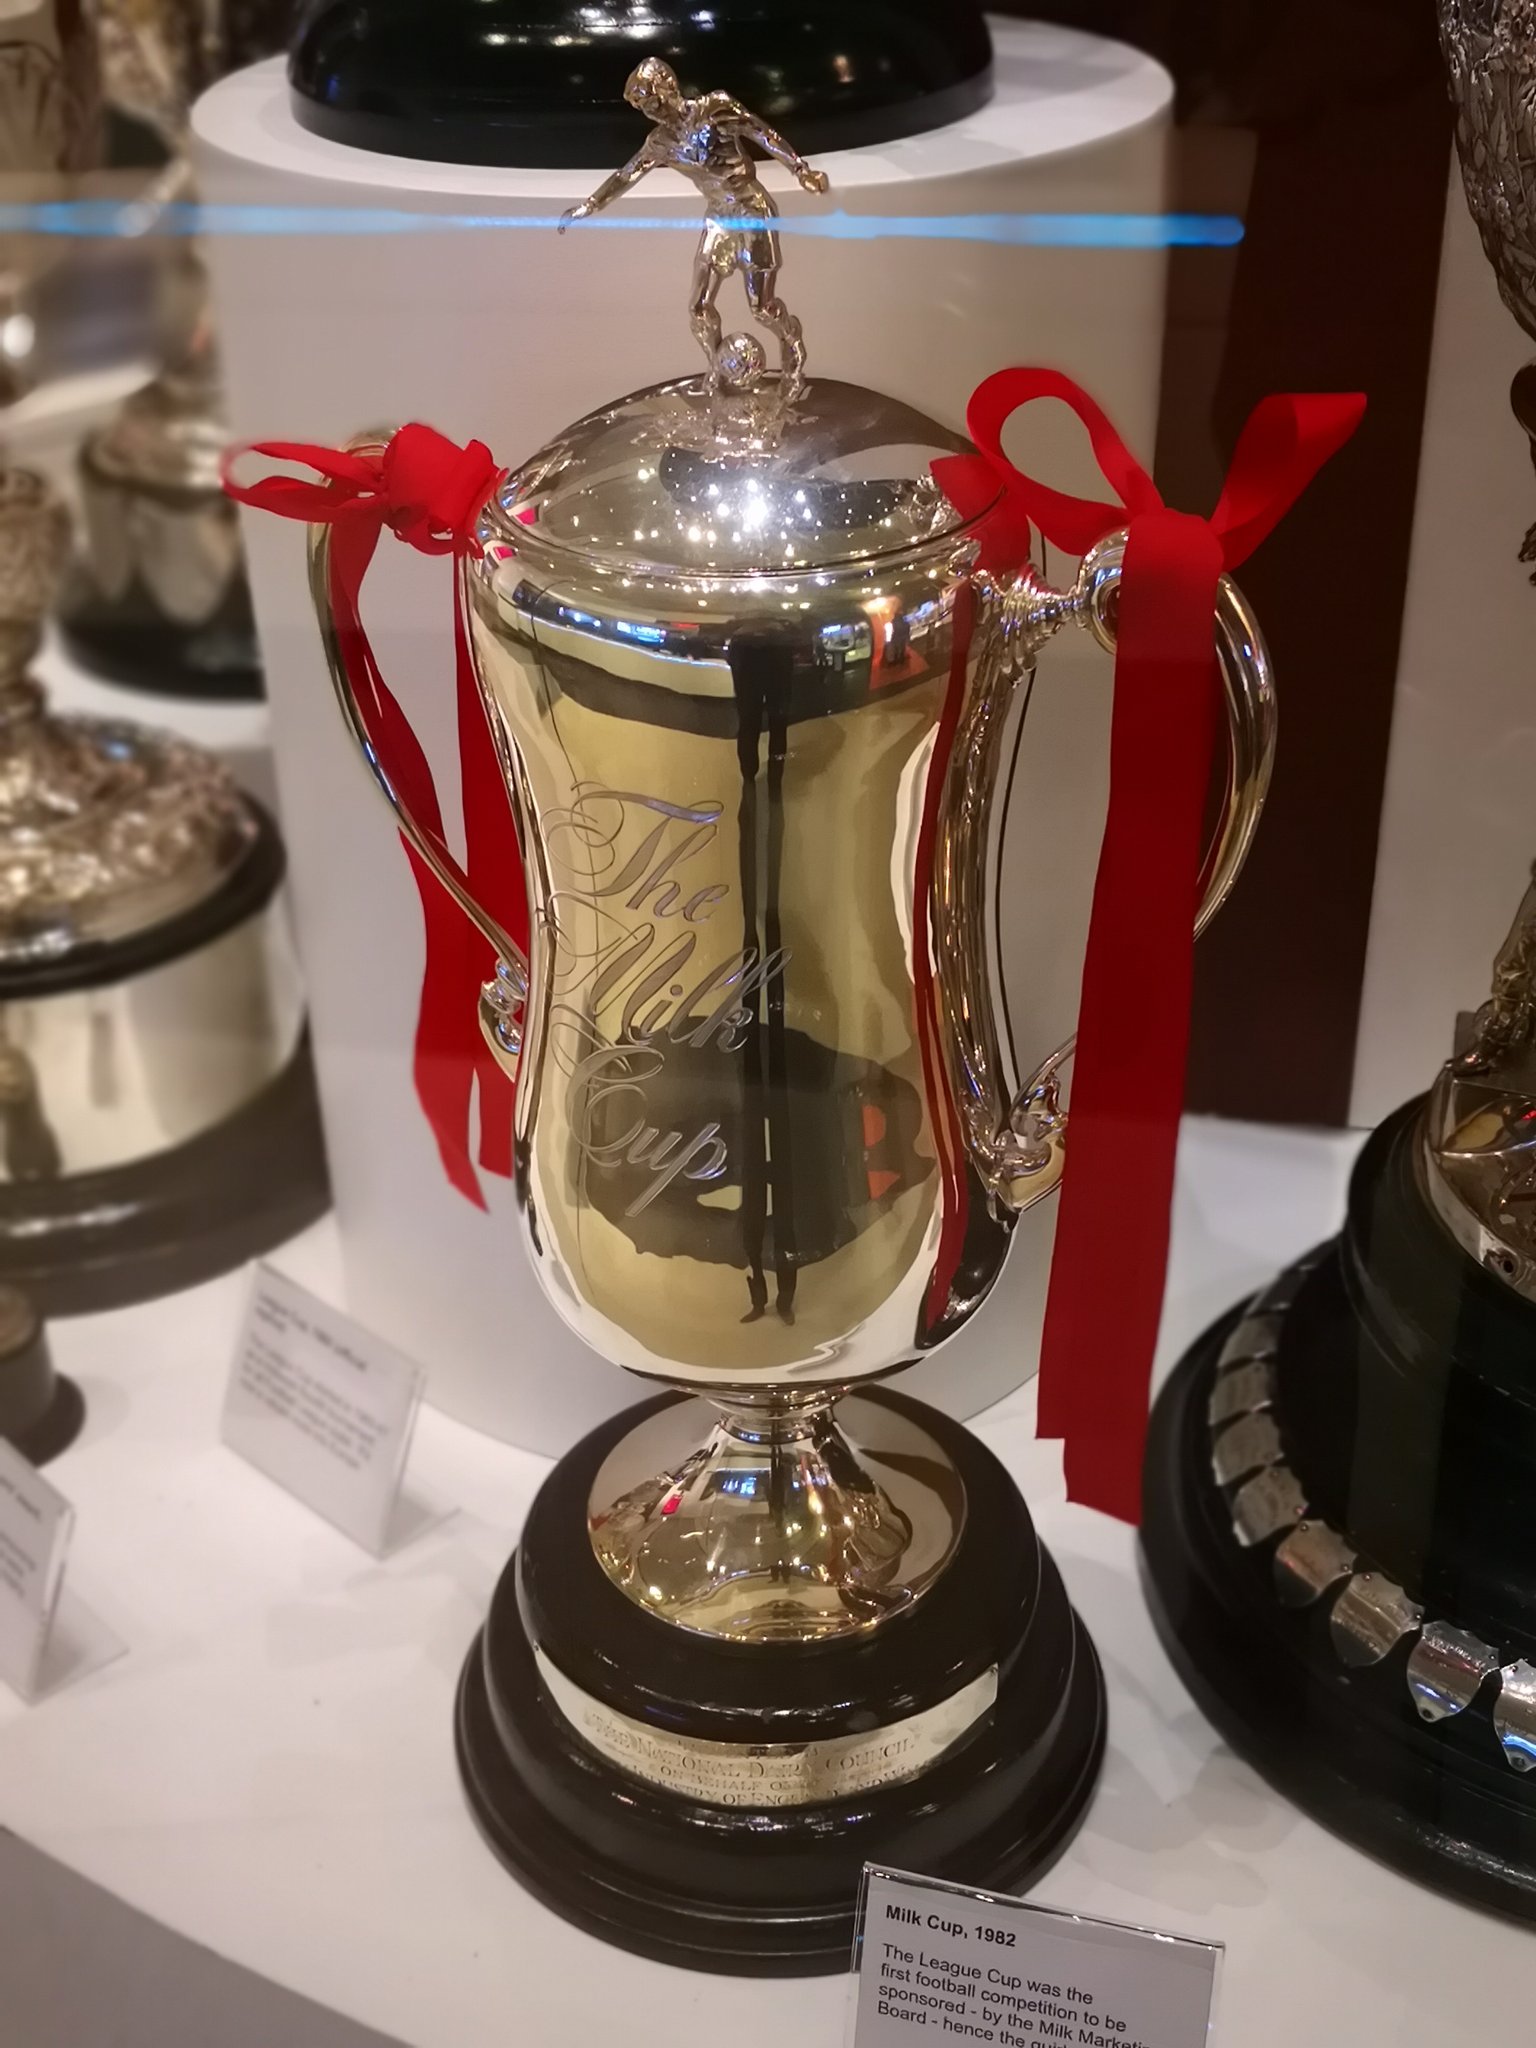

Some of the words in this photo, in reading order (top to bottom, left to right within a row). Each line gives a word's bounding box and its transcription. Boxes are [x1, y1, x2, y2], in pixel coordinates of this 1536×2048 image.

[542, 781, 729, 922] The
[545, 891, 792, 1052] Milk
[551, 1004, 728, 1217] Cup
[886, 1904, 921, 1926] Milk
[927, 1914, 968, 1939] Cup,
[975, 1926, 1016, 1947] 1982
[881, 1963, 911, 1982] first
[916, 1971, 975, 1998] football
[981, 1990, 1077, 2022] competition
[1084, 2011, 1099, 2026] to
[1105, 2015, 1127, 2032] be
[882, 1943, 914, 1963] The
[920, 1952, 981, 1979] League
[988, 1968, 1022, 1990] Cup
[1027, 1980, 1061, 1997] was
[1067, 1987, 1093, 2004] the
[878, 2000, 926, 2024] Board
[943, 2016, 994, 2041] hence
[1000, 2031, 1025, 2048] the
[879, 1985, 965, 2014] sponsored
[982, 2006, 1002, 2026] by
[1008, 2013, 1033, 2030] the
[1039, 2019, 1073, 2041] Milk
